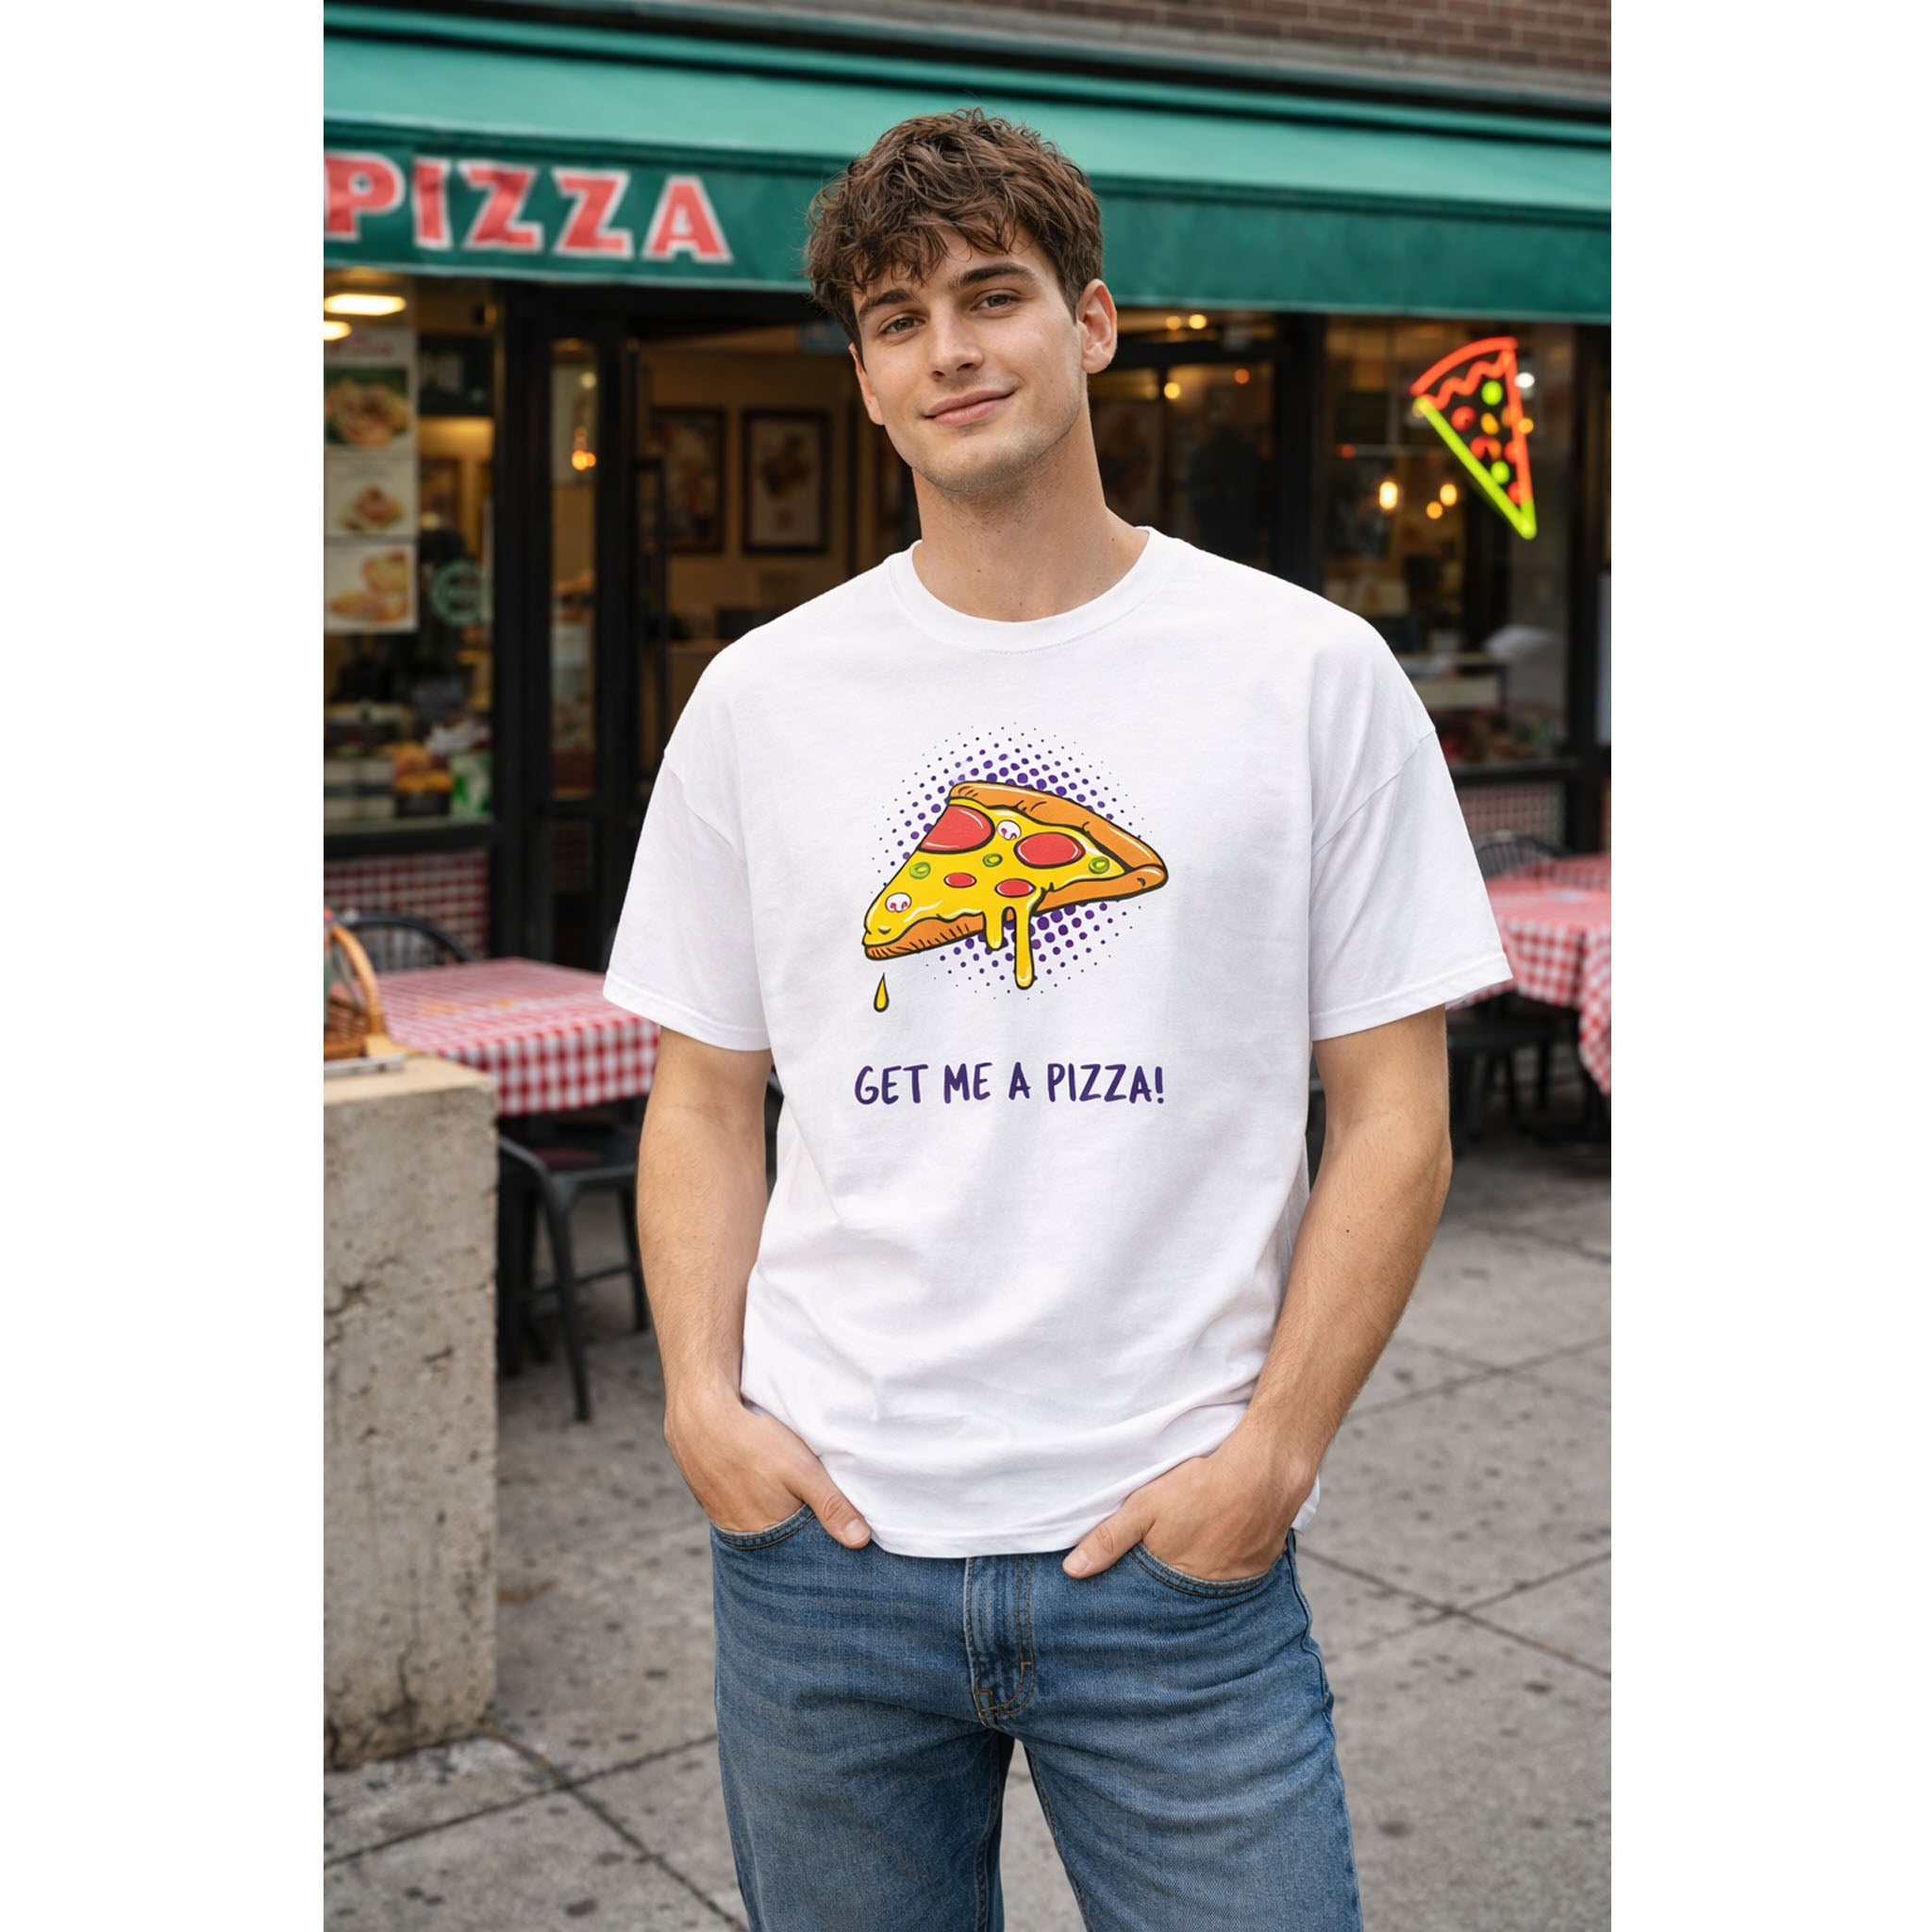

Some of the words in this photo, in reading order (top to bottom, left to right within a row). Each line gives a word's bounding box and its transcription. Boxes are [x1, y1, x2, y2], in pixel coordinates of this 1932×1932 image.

[324, 150, 734, 263] PIZZA
[854, 1063, 929, 1106] GET
[943, 1062, 992, 1104] ME
[1008, 1061, 1031, 1100] A
[1047, 1062, 1164, 1105] PIZZA!
